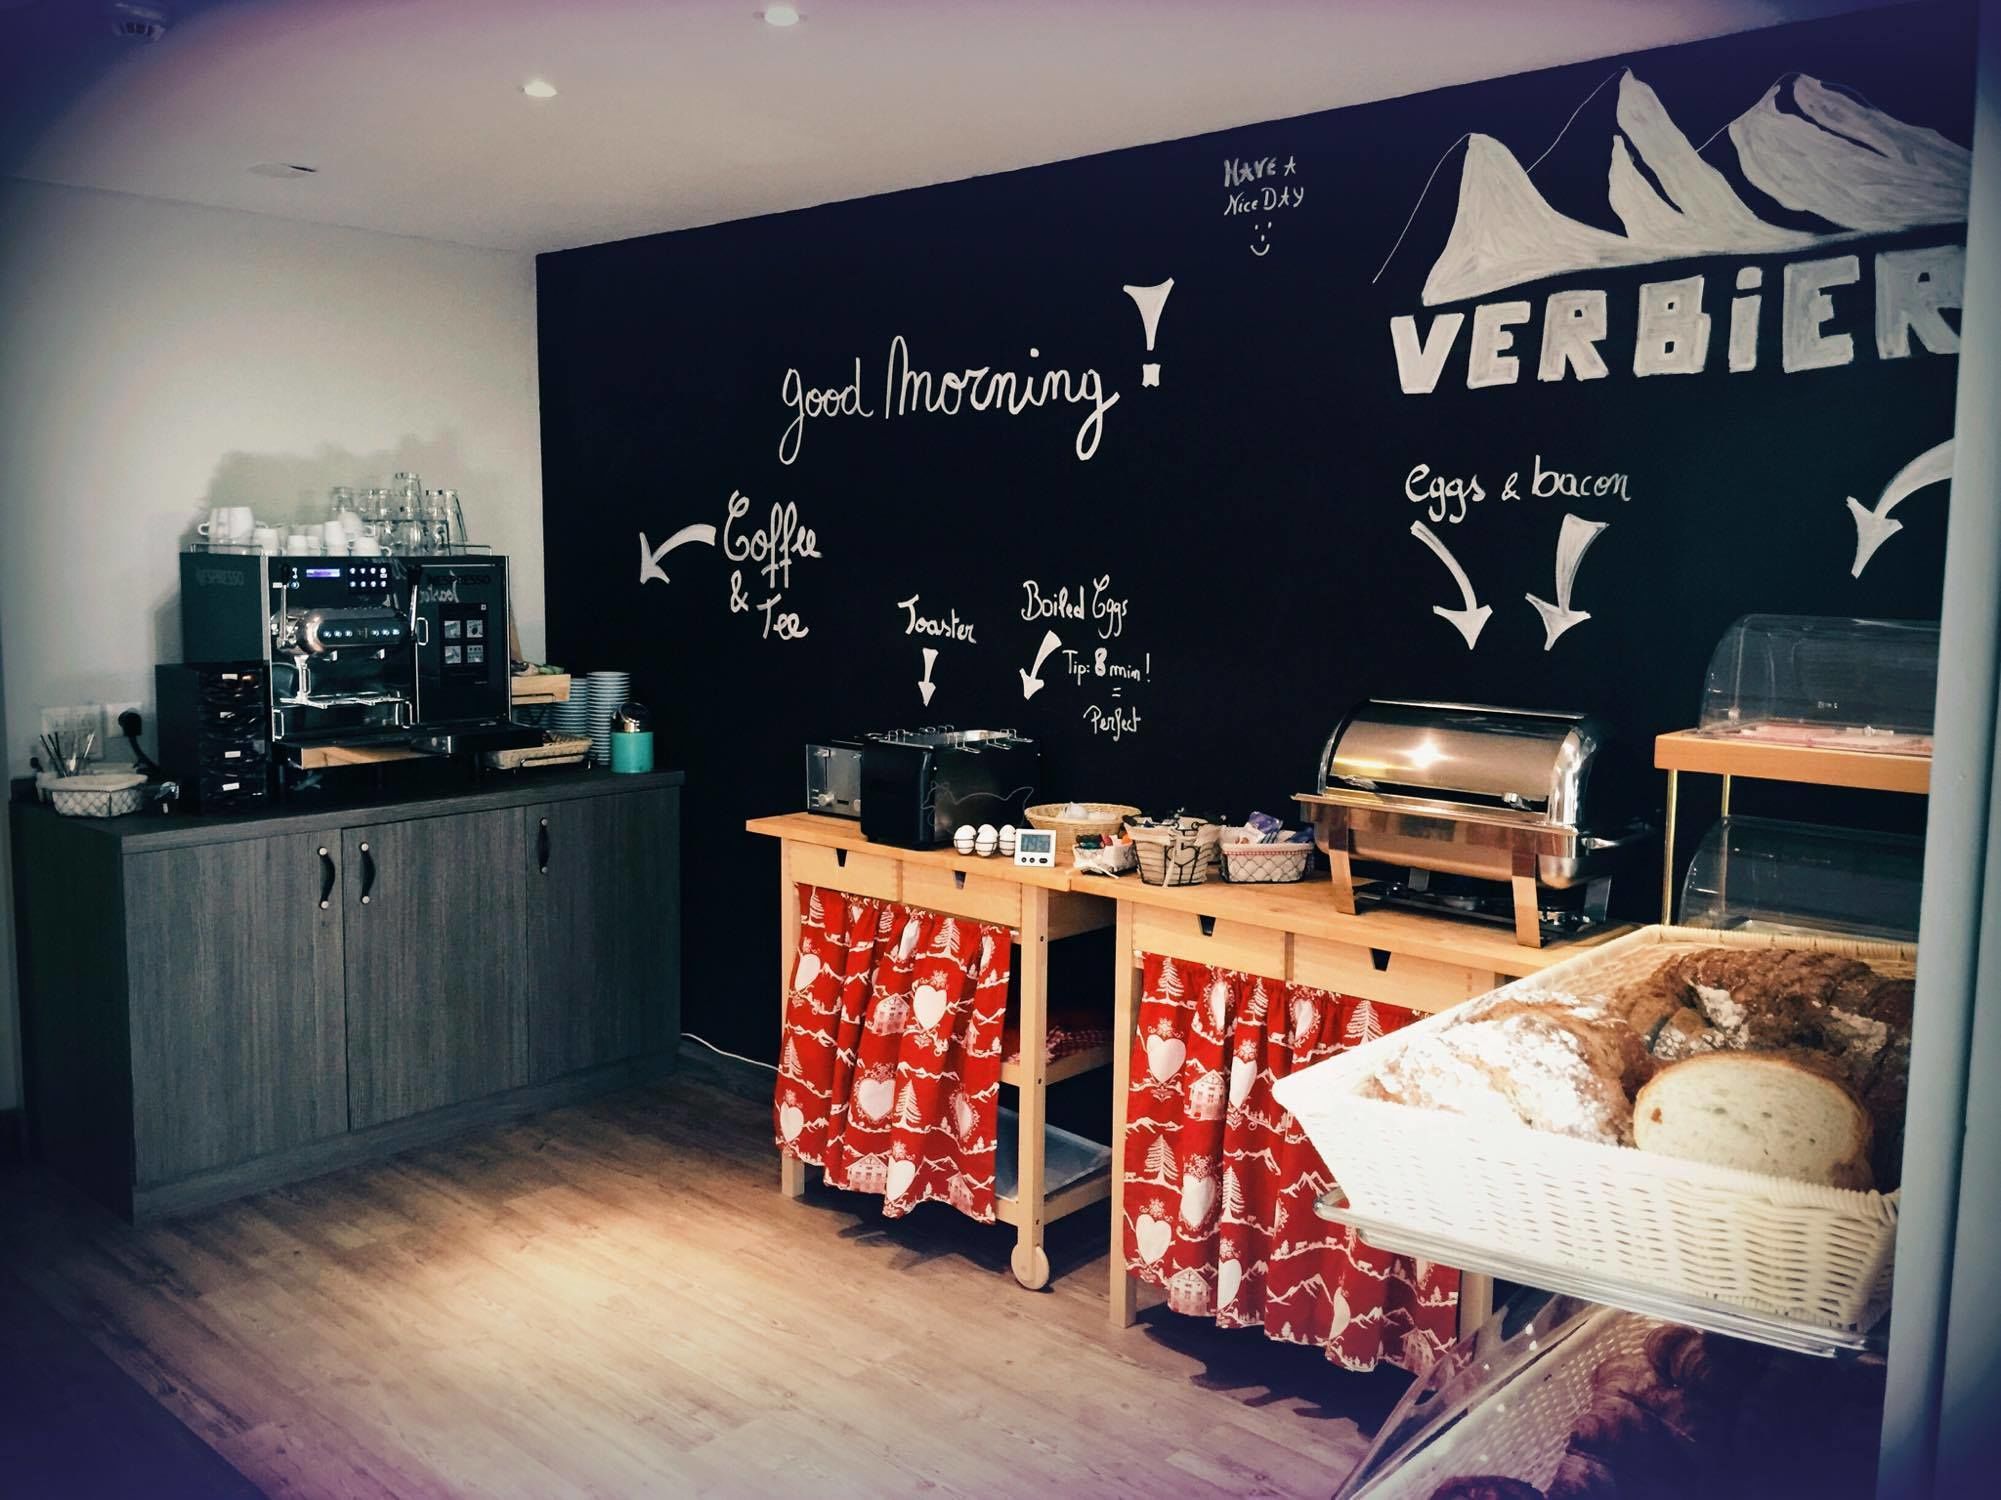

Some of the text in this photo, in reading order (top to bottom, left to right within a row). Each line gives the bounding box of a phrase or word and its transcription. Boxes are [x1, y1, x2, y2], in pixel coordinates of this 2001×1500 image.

[1223, 155, 1296, 188] HAVE A
[1261, 186, 1304, 211] DAY
[1405, 455, 1631, 523] eggs & bacon
[723, 489, 823, 589] Coffee
[730, 569, 810, 641] & Tee
[897, 594, 977, 643] Toaster
[1021, 574, 1129, 639] Boiled Eggs
[1095, 647, 1108, 677] 8
[1082, 704, 1142, 742] Perfect
